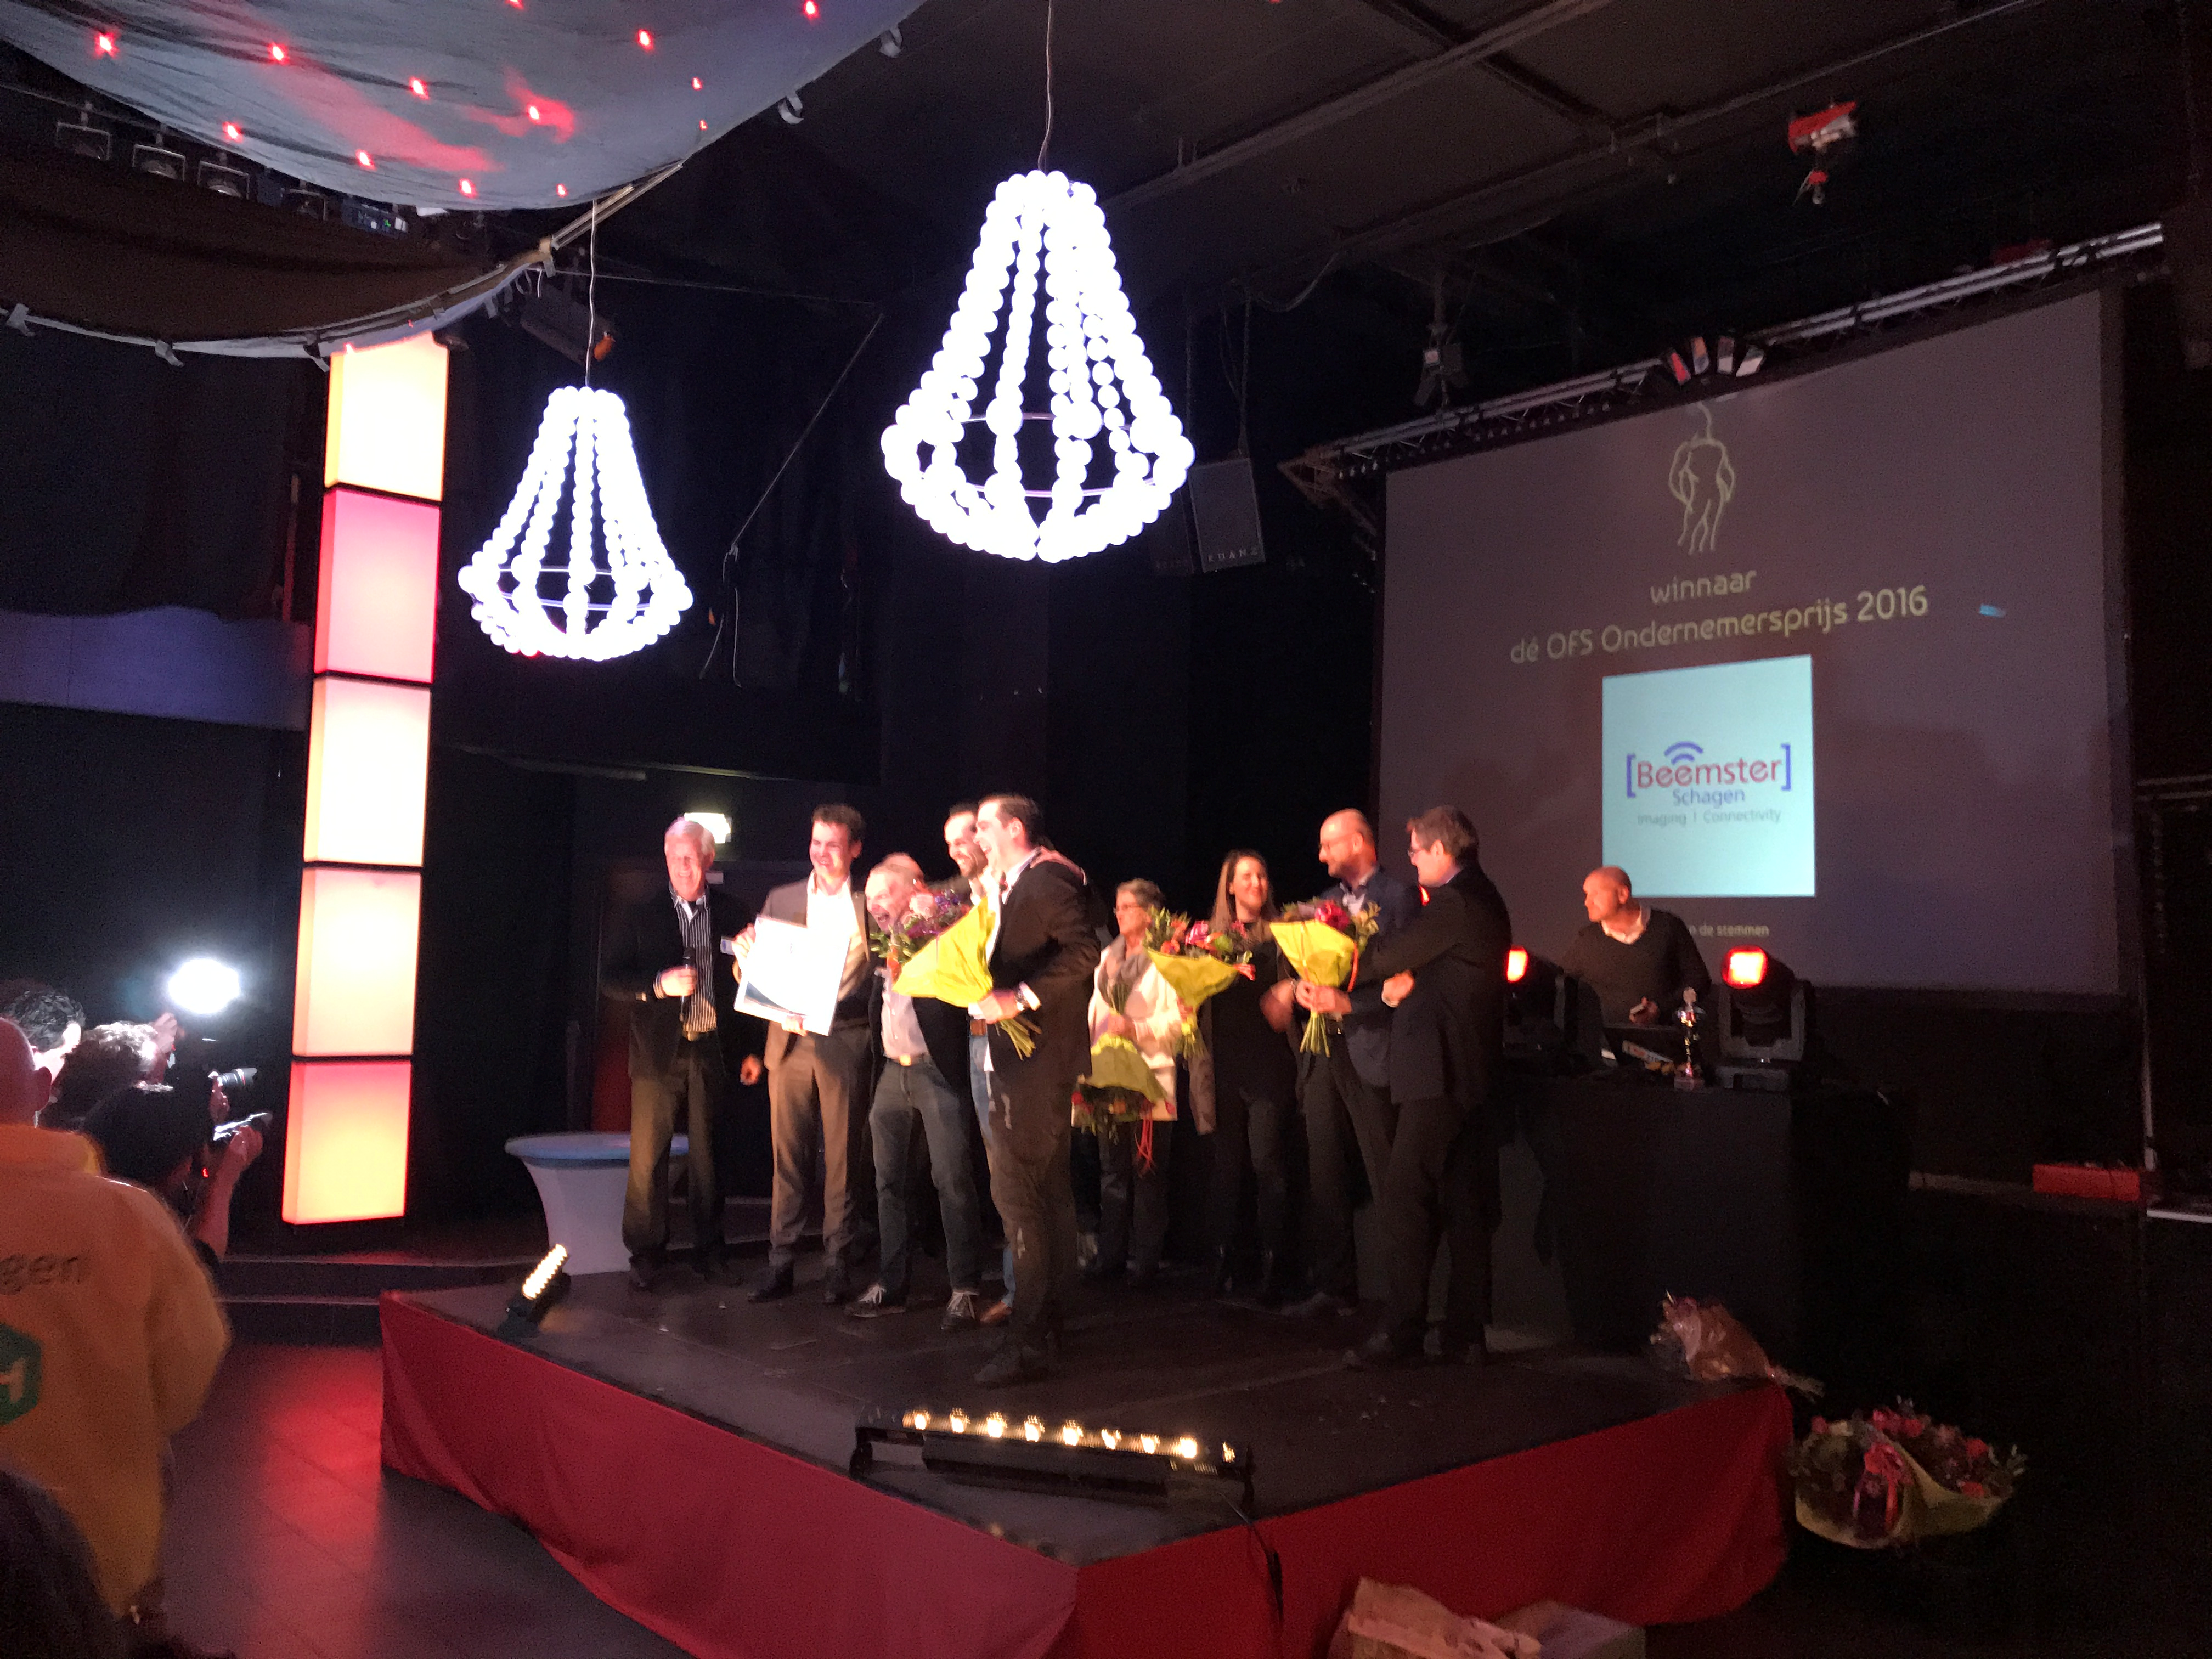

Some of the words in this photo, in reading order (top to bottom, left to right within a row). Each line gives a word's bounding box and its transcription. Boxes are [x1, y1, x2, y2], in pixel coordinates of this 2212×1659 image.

[1650, 569, 1757, 604] winnaar
[1510, 636, 1539, 664] dé
[1546, 628, 1594, 659] OFS
[1601, 597, 1848, 653] Ondernemersprijs
[1857, 584, 1929, 623] 2016
[1672, 788, 1745, 809] Schagen
[1703, 808, 1781, 824] Connectivity
